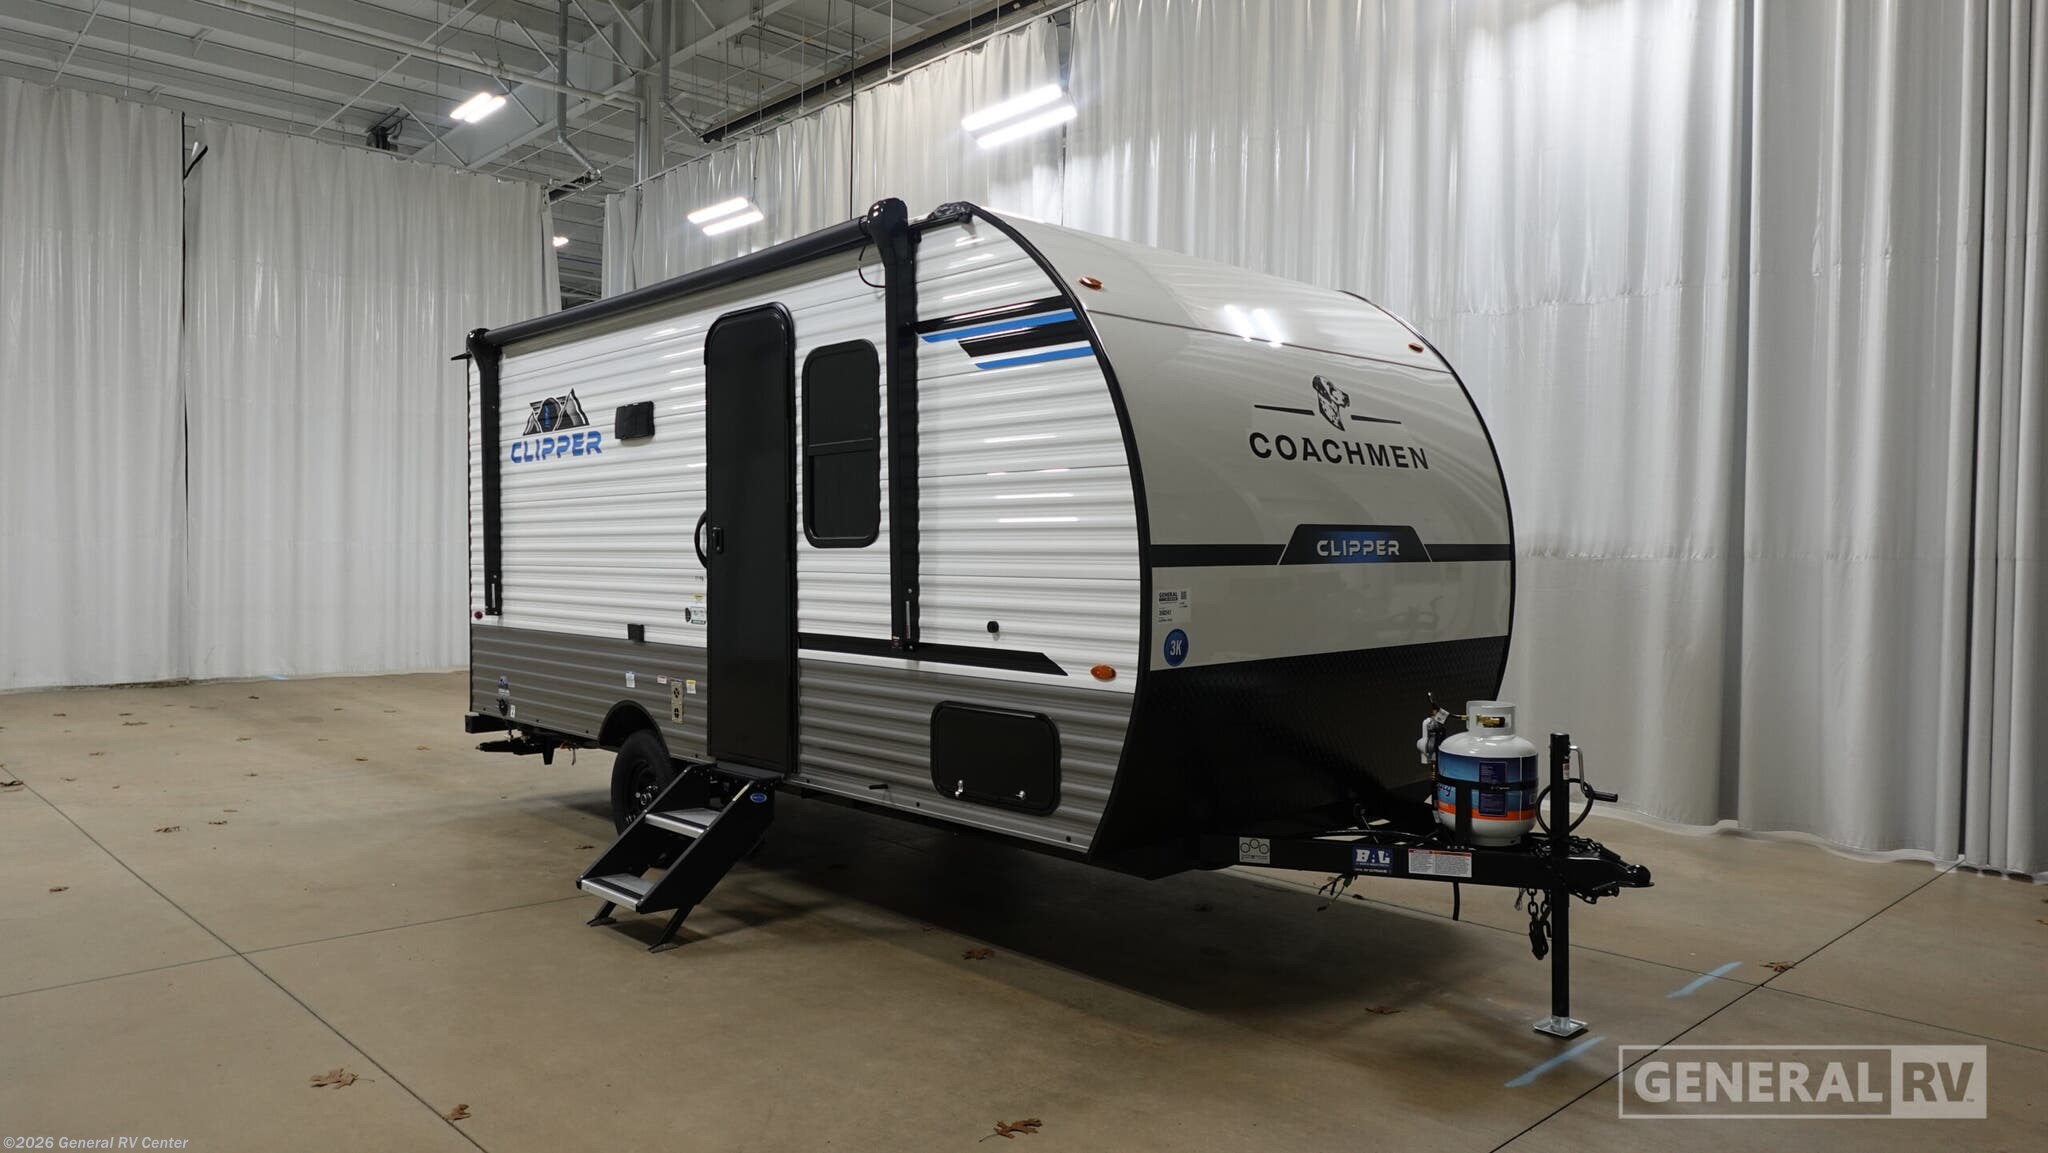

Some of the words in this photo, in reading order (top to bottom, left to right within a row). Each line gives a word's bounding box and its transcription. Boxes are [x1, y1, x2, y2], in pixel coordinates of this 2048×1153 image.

[511, 430, 602, 463] CLIPPER
[1249, 432, 1429, 470] COACHMEN
[1316, 540, 1400, 557] CLIPPER
[1169, 640, 1182, 656] 3K
